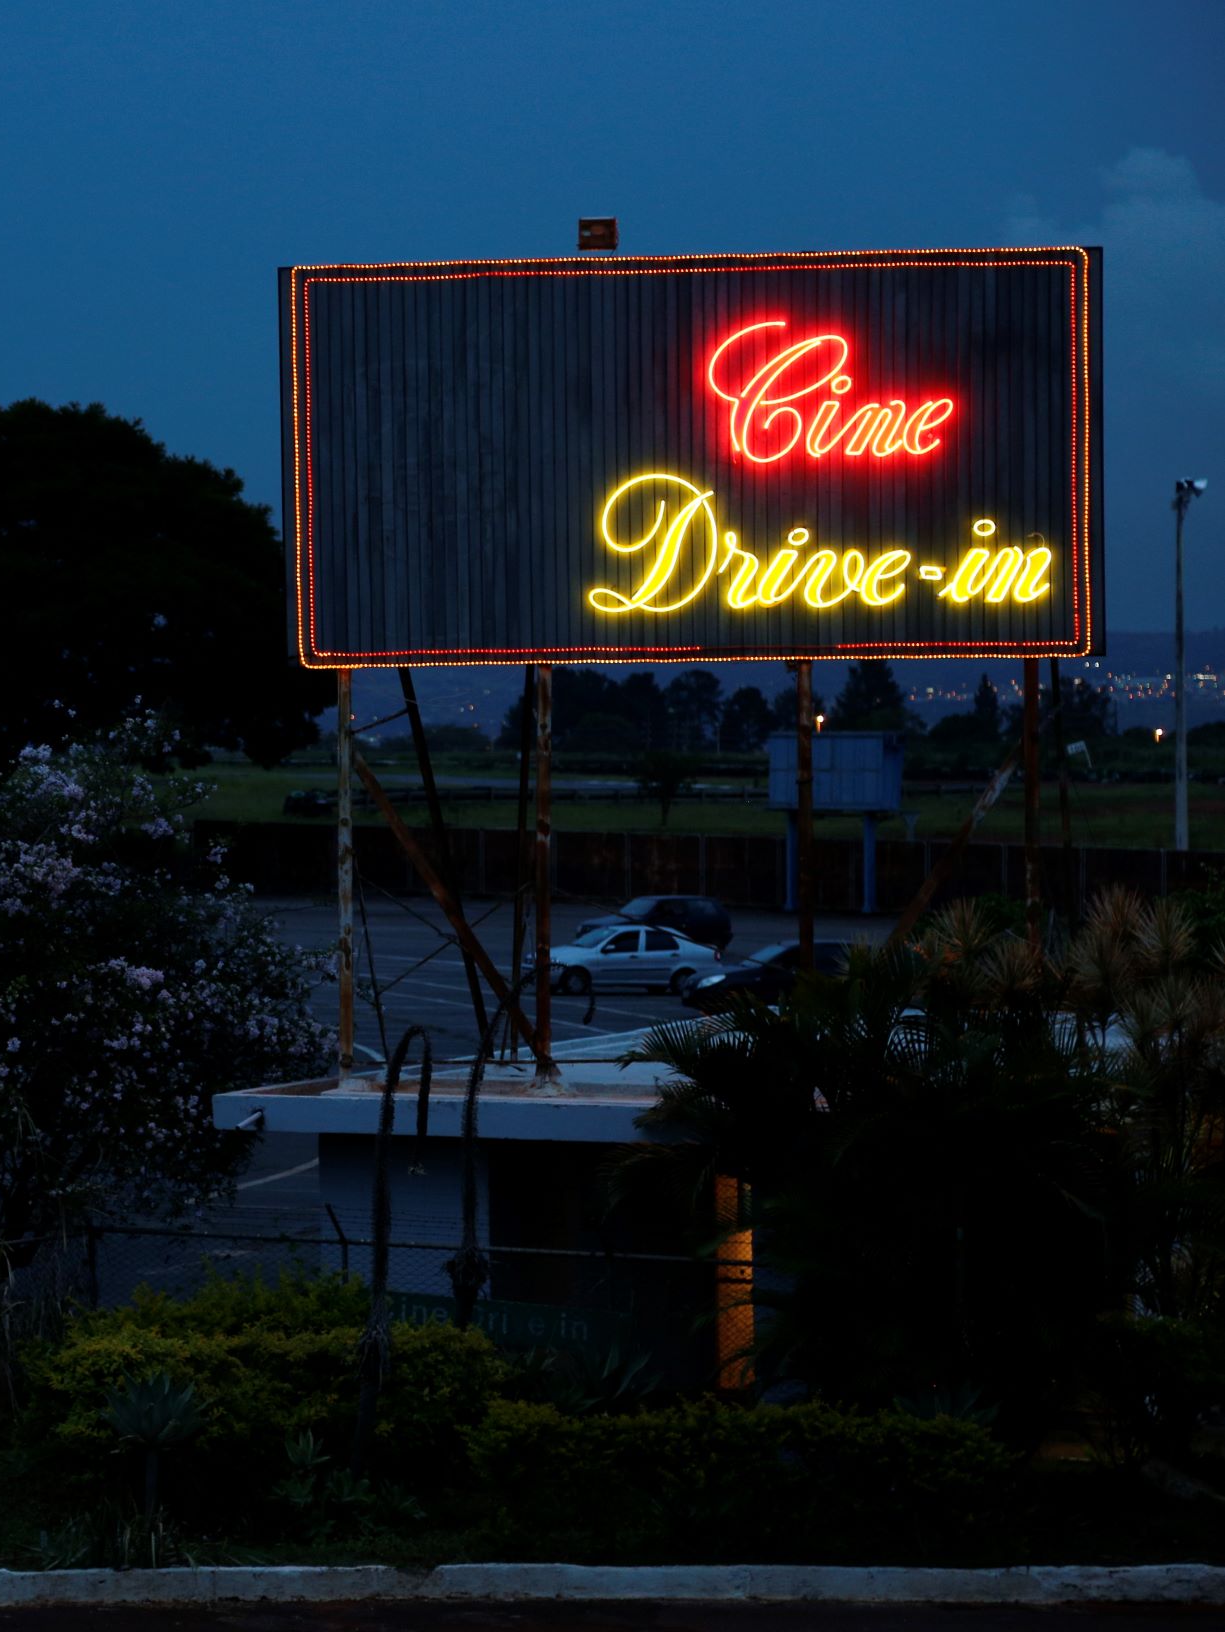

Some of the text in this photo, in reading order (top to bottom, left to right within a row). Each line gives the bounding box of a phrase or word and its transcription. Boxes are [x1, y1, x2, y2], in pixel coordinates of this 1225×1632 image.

[708, 321, 954, 463] Cine
[588, 473, 1052, 613] Drive-in
[387, 1296, 449, 1327] ine
